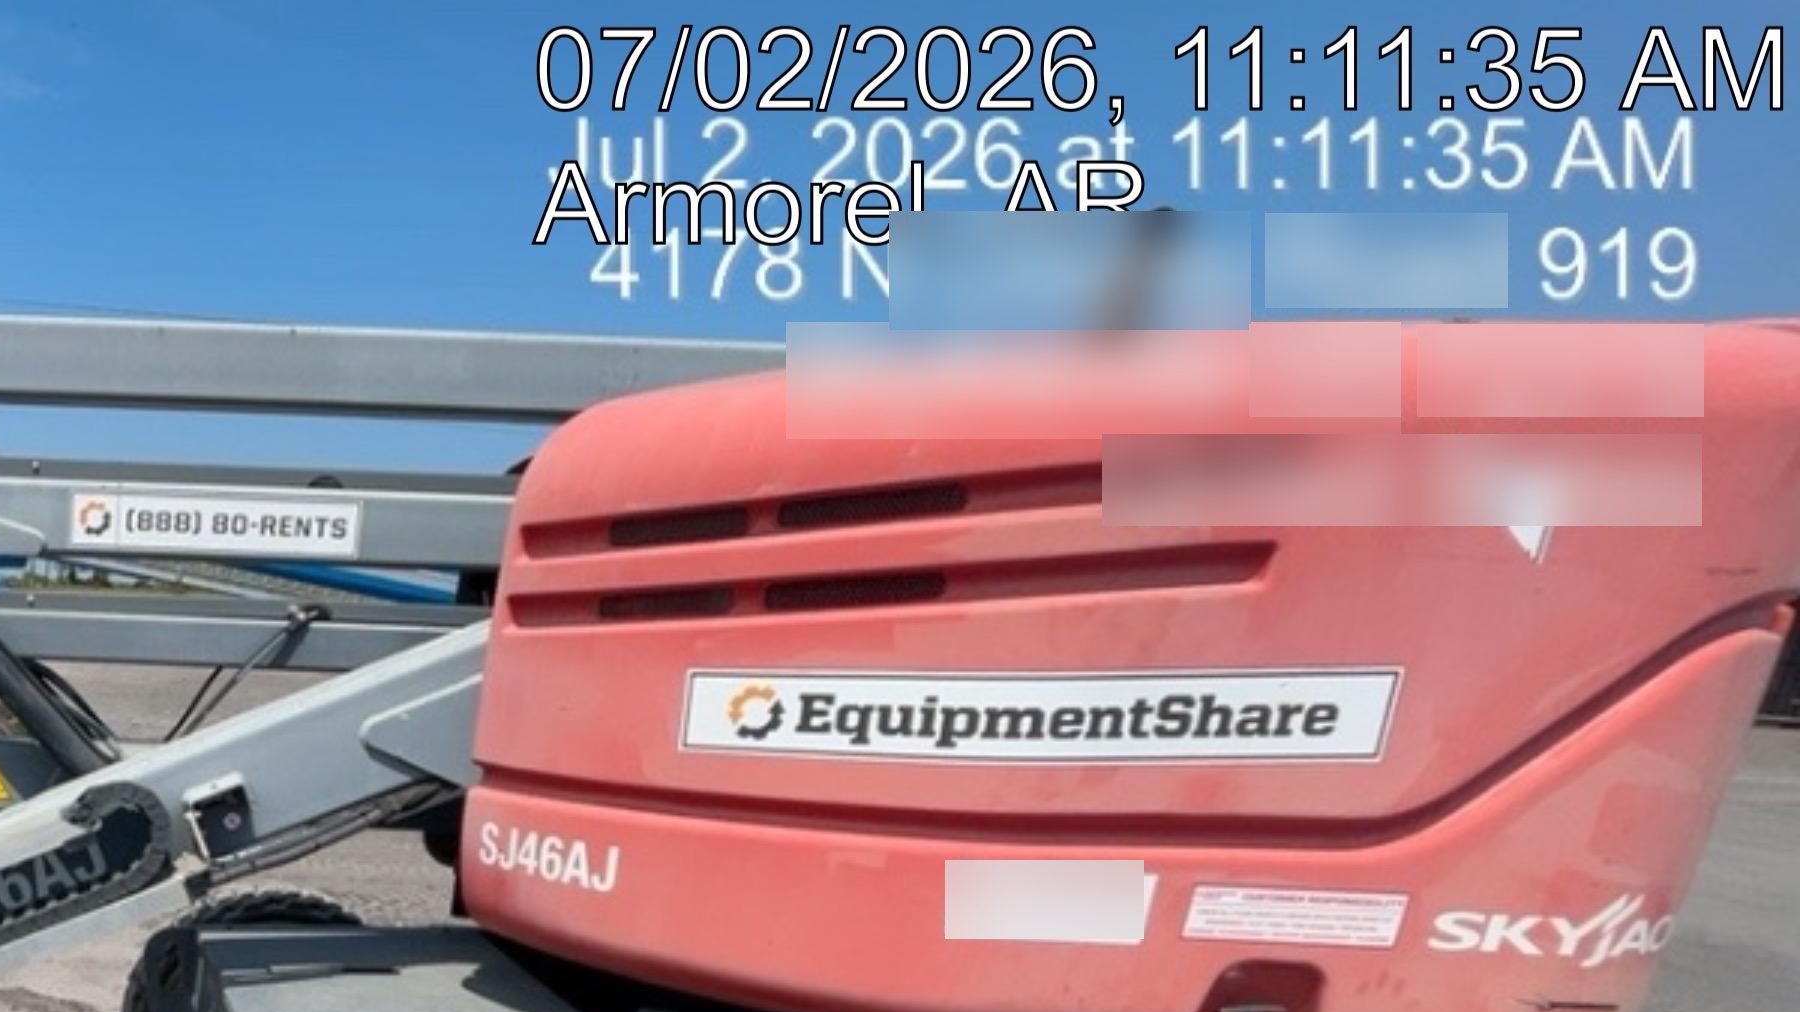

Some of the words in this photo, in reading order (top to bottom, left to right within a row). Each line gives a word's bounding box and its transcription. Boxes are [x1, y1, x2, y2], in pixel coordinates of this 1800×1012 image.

[125, 508, 202, 535] (888)
[211, 511, 349, 540] 80-RENTS
[794, 692, 1338, 749] EquipmentShare
[479, 821, 620, 892] SJ46AJ
[1426, 893, 1673, 968] SKYJAC
